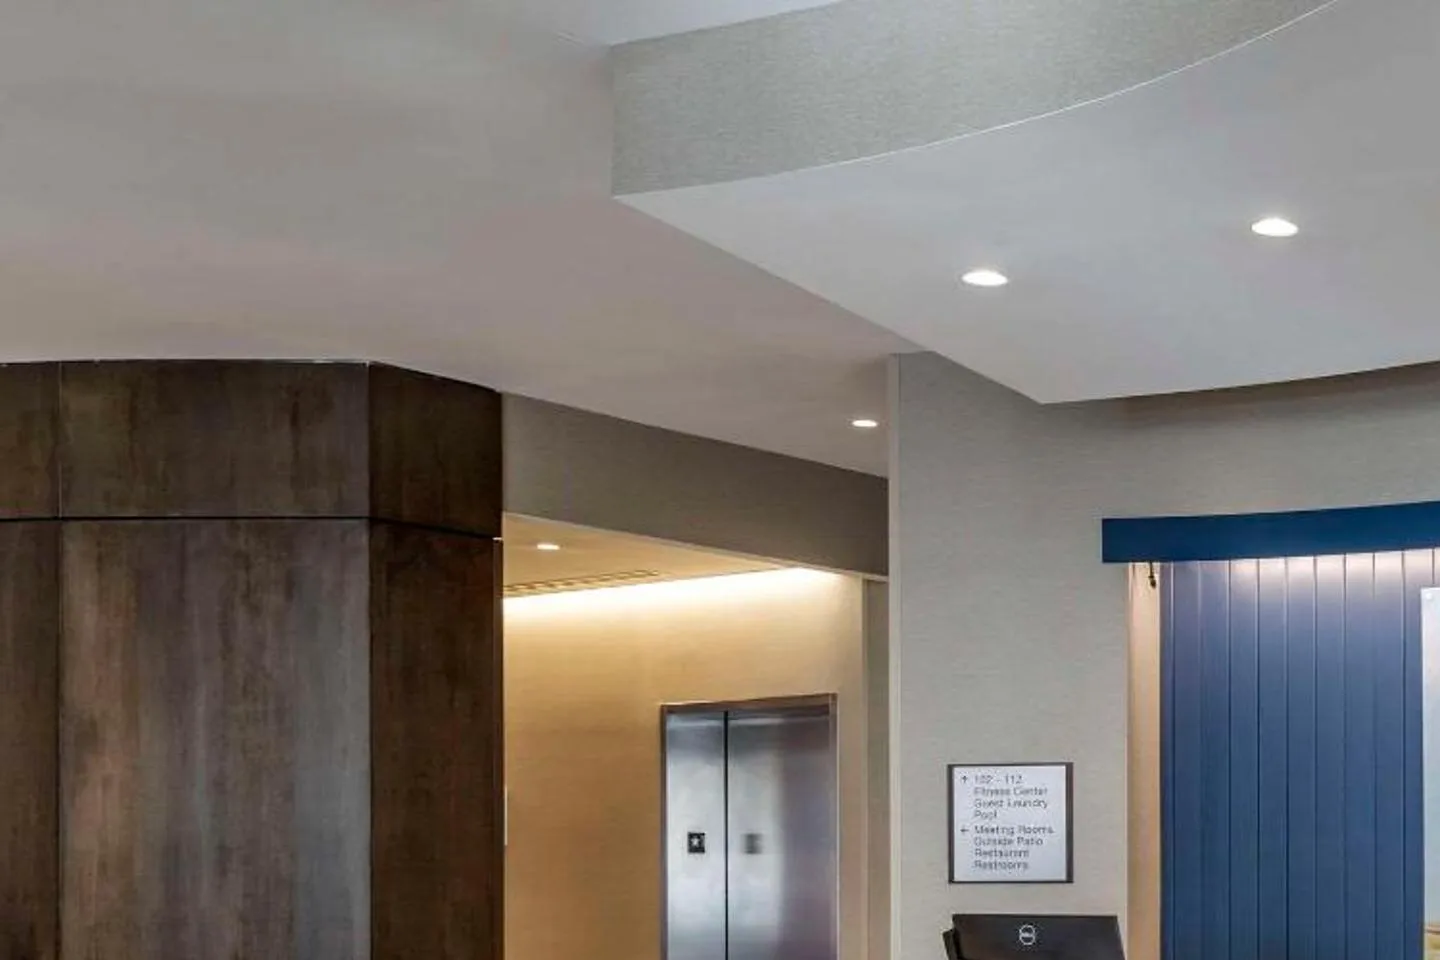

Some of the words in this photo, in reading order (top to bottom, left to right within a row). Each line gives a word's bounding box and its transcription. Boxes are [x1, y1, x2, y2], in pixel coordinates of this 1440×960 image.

[974, 799, 1003, 808] Guest
[1008, 799, 1047, 809] Laundry
[974, 811, 997, 820] Pool
[975, 826, 1014, 835] Meeting
[1017, 837, 1043, 845] Patio
[974, 860, 1028, 869] Restrooms
